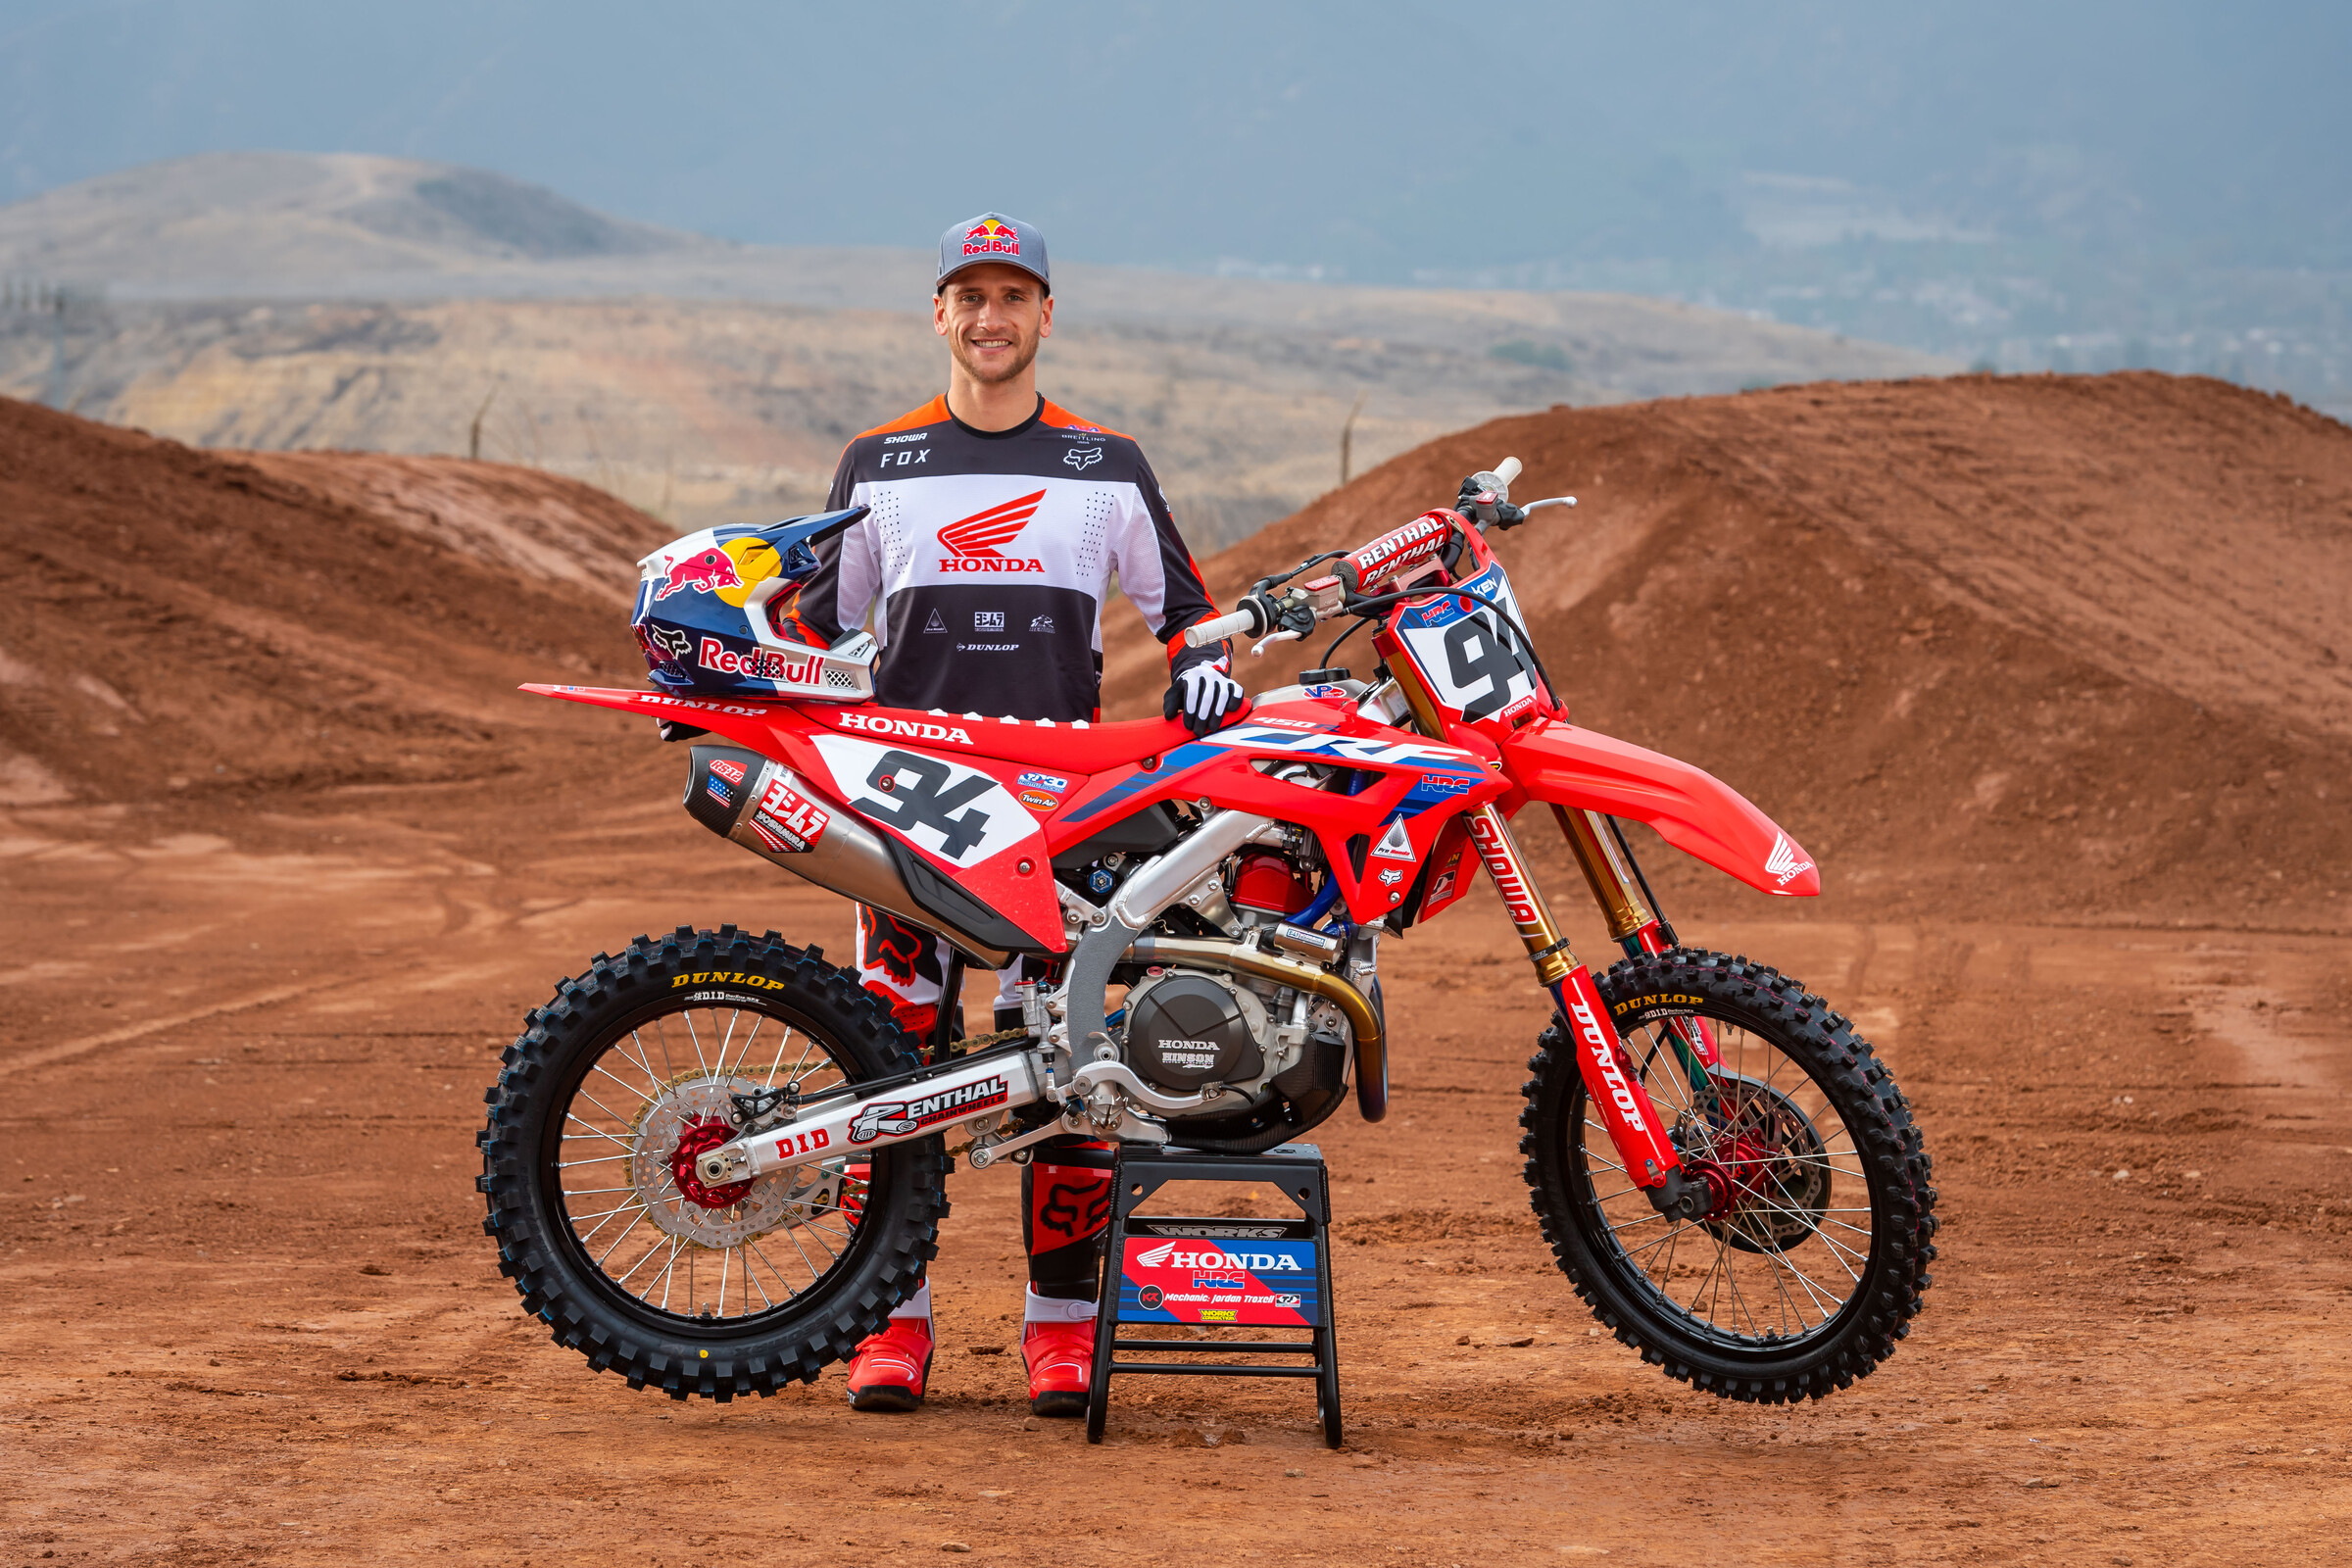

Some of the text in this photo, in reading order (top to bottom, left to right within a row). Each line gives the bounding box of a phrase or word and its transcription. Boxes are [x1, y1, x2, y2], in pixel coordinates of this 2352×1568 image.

[962, 239, 1019, 256] Red Bull
[883, 432, 928, 444] SHOWA
[880, 449, 931, 468] FOX
[1357, 517, 1445, 569] RENTHAL
[939, 558, 1046, 573] HONDA
[1362, 534, 1445, 587] RENTHAL
[1471, 577, 1497, 597] KEN
[1422, 600, 1454, 627] HRC
[699, 637, 825, 685] Red Bull
[1304, 685, 1333, 698] VP
[639, 694, 767, 716] DUNLOP
[1503, 697, 1533, 717] HONDA
[839, 712, 974, 745] HONDA
[1421, 775, 1470, 795] HRC
[850, 750, 1002, 860] 94
[1022, 794, 1055, 808] Twin Air
[755, 810, 806, 851] YOSHIMURA
[1470, 815, 1540, 925] SHOWA
[1777, 860, 1813, 886] HONDA
[671, 971, 785, 990] DUNLOP
[1614, 993, 1703, 1015] DUNLOP
[1158, 1039, 1220, 1051] HONDA
[1162, 1052, 1214, 1062] HINSON
[1570, 1001, 1645, 1132] DUNLOP
[919, 1094, 1005, 1125] CHAINWHEELS
[776, 1129, 829, 1159] D.I.D
[1154, 1226, 1282, 1238] WORKS
[1170, 1251, 1301, 1271] HONDA
[1193, 1270, 1245, 1289] HRC
[1164, 1293, 1275, 1304] Mechanic: Jordan Troxell
